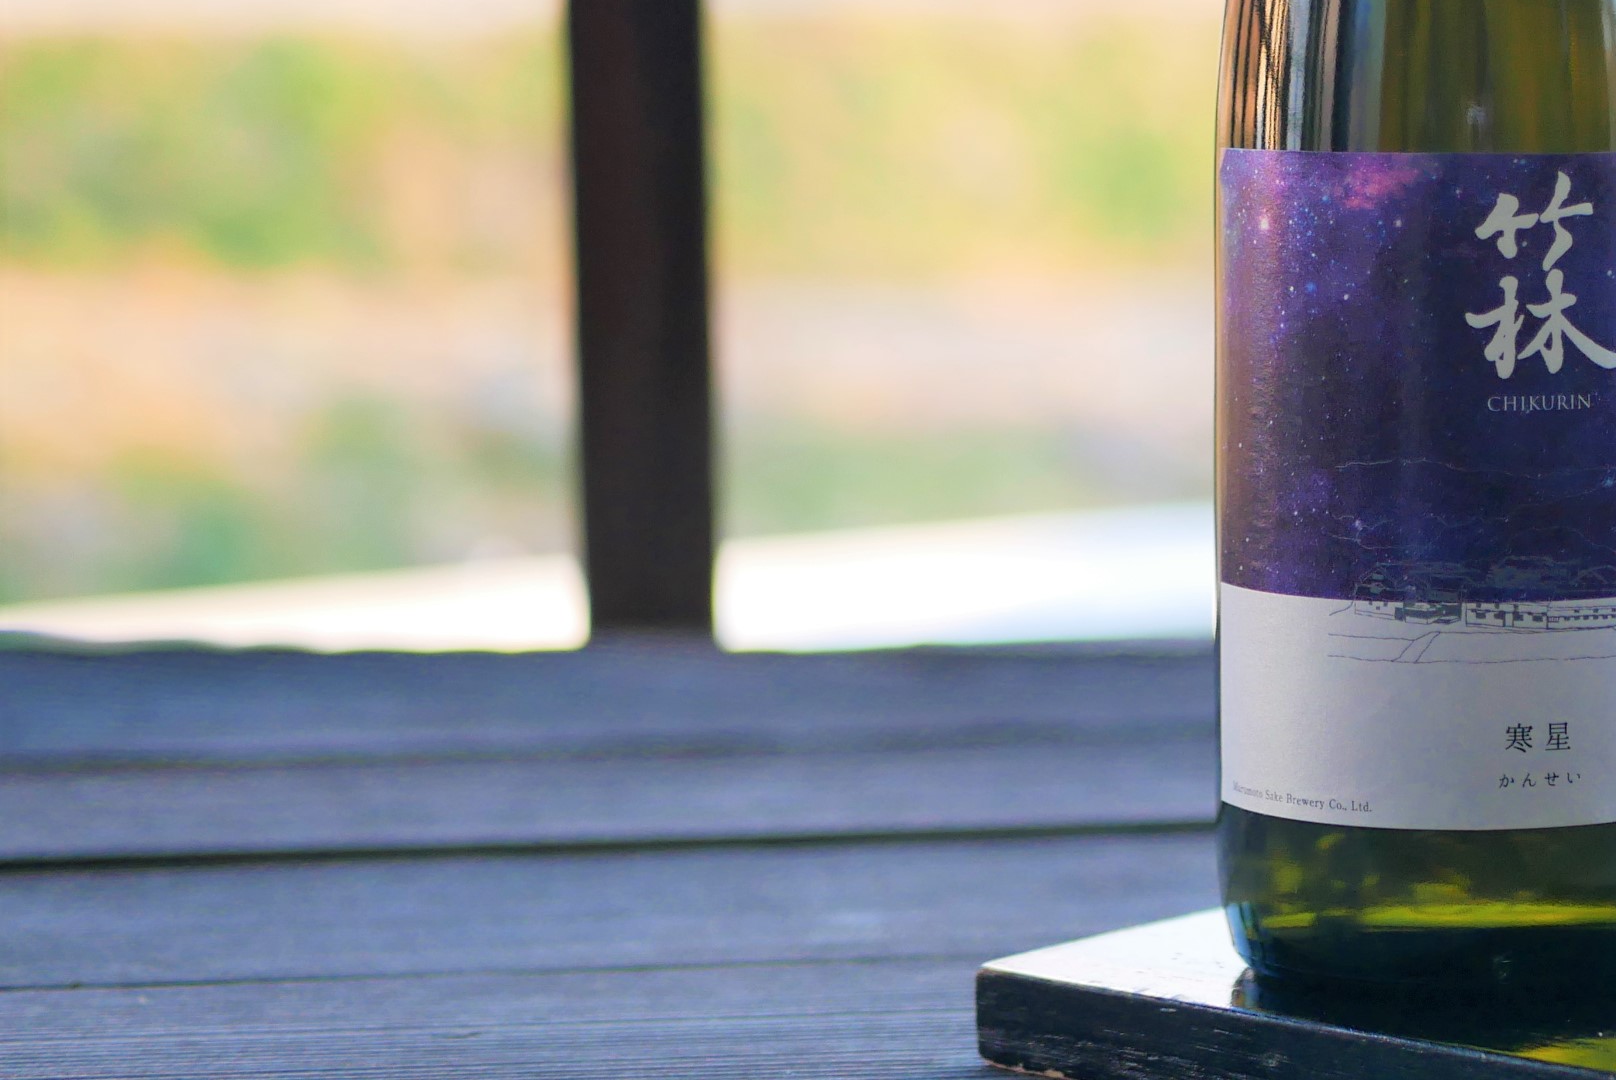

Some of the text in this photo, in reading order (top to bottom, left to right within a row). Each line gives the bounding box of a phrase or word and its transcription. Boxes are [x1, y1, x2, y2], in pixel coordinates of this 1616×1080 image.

[1487, 394, 1592, 412] CHIKURIN
[1505, 722, 1571, 753] 寒星
[1499, 772, 1581, 789] かんせい
[1265, 789, 1283, 803] Sake
[1286, 793, 1325, 810] Brewery
[1351, 800, 1372, 813] Ltd.
